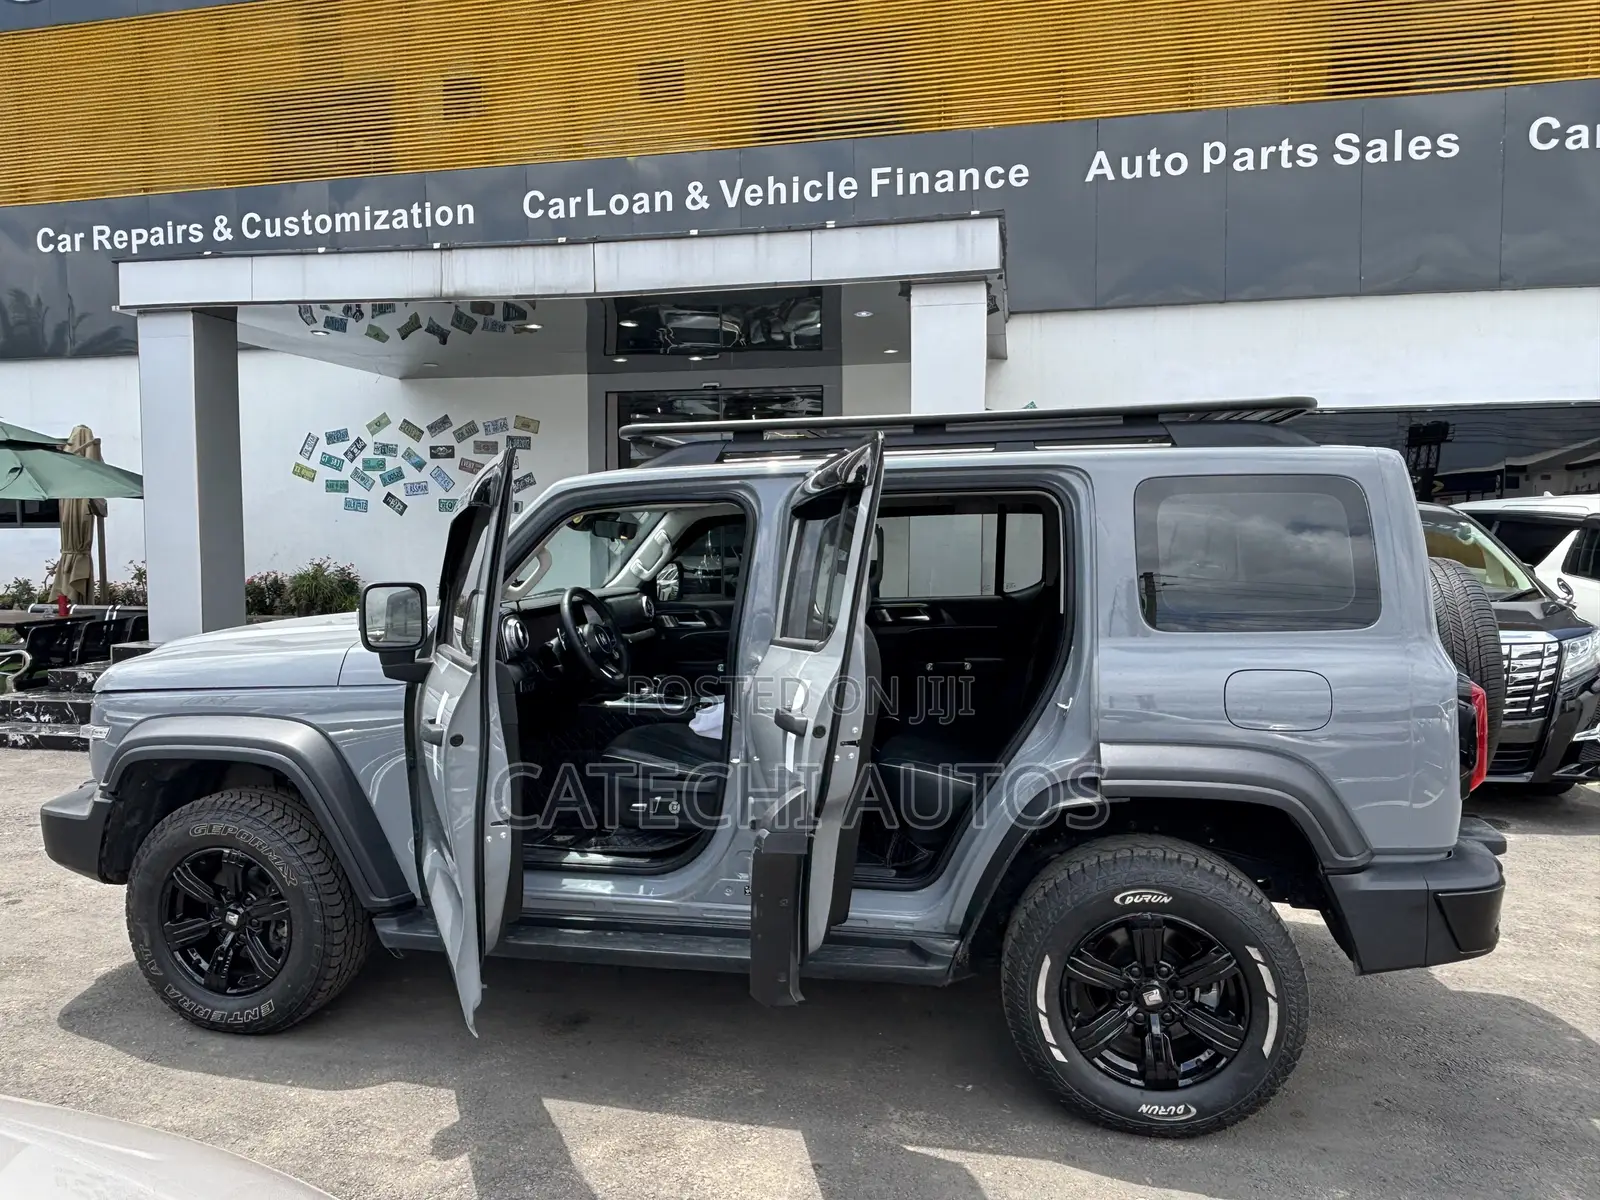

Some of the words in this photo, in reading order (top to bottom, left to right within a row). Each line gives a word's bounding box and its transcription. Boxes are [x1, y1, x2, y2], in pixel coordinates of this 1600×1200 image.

[1084, 146, 1189, 183] Auto
[1332, 129, 1460, 166] Sales
[685, 181, 711, 211] &
[718, 171, 858, 208] Vehicle
[871, 163, 1030, 198] Finance
[36, 226, 85, 253] Car
[92, 219, 204, 254] Repairs
[212, 214, 234, 242] &
[241, 201, 475, 240] Customization
[1124, 893, 1173, 905] DURUN
[163, 983, 276, 1024] ENTERRA
[1137, 1103, 1186, 1116] DURUN
